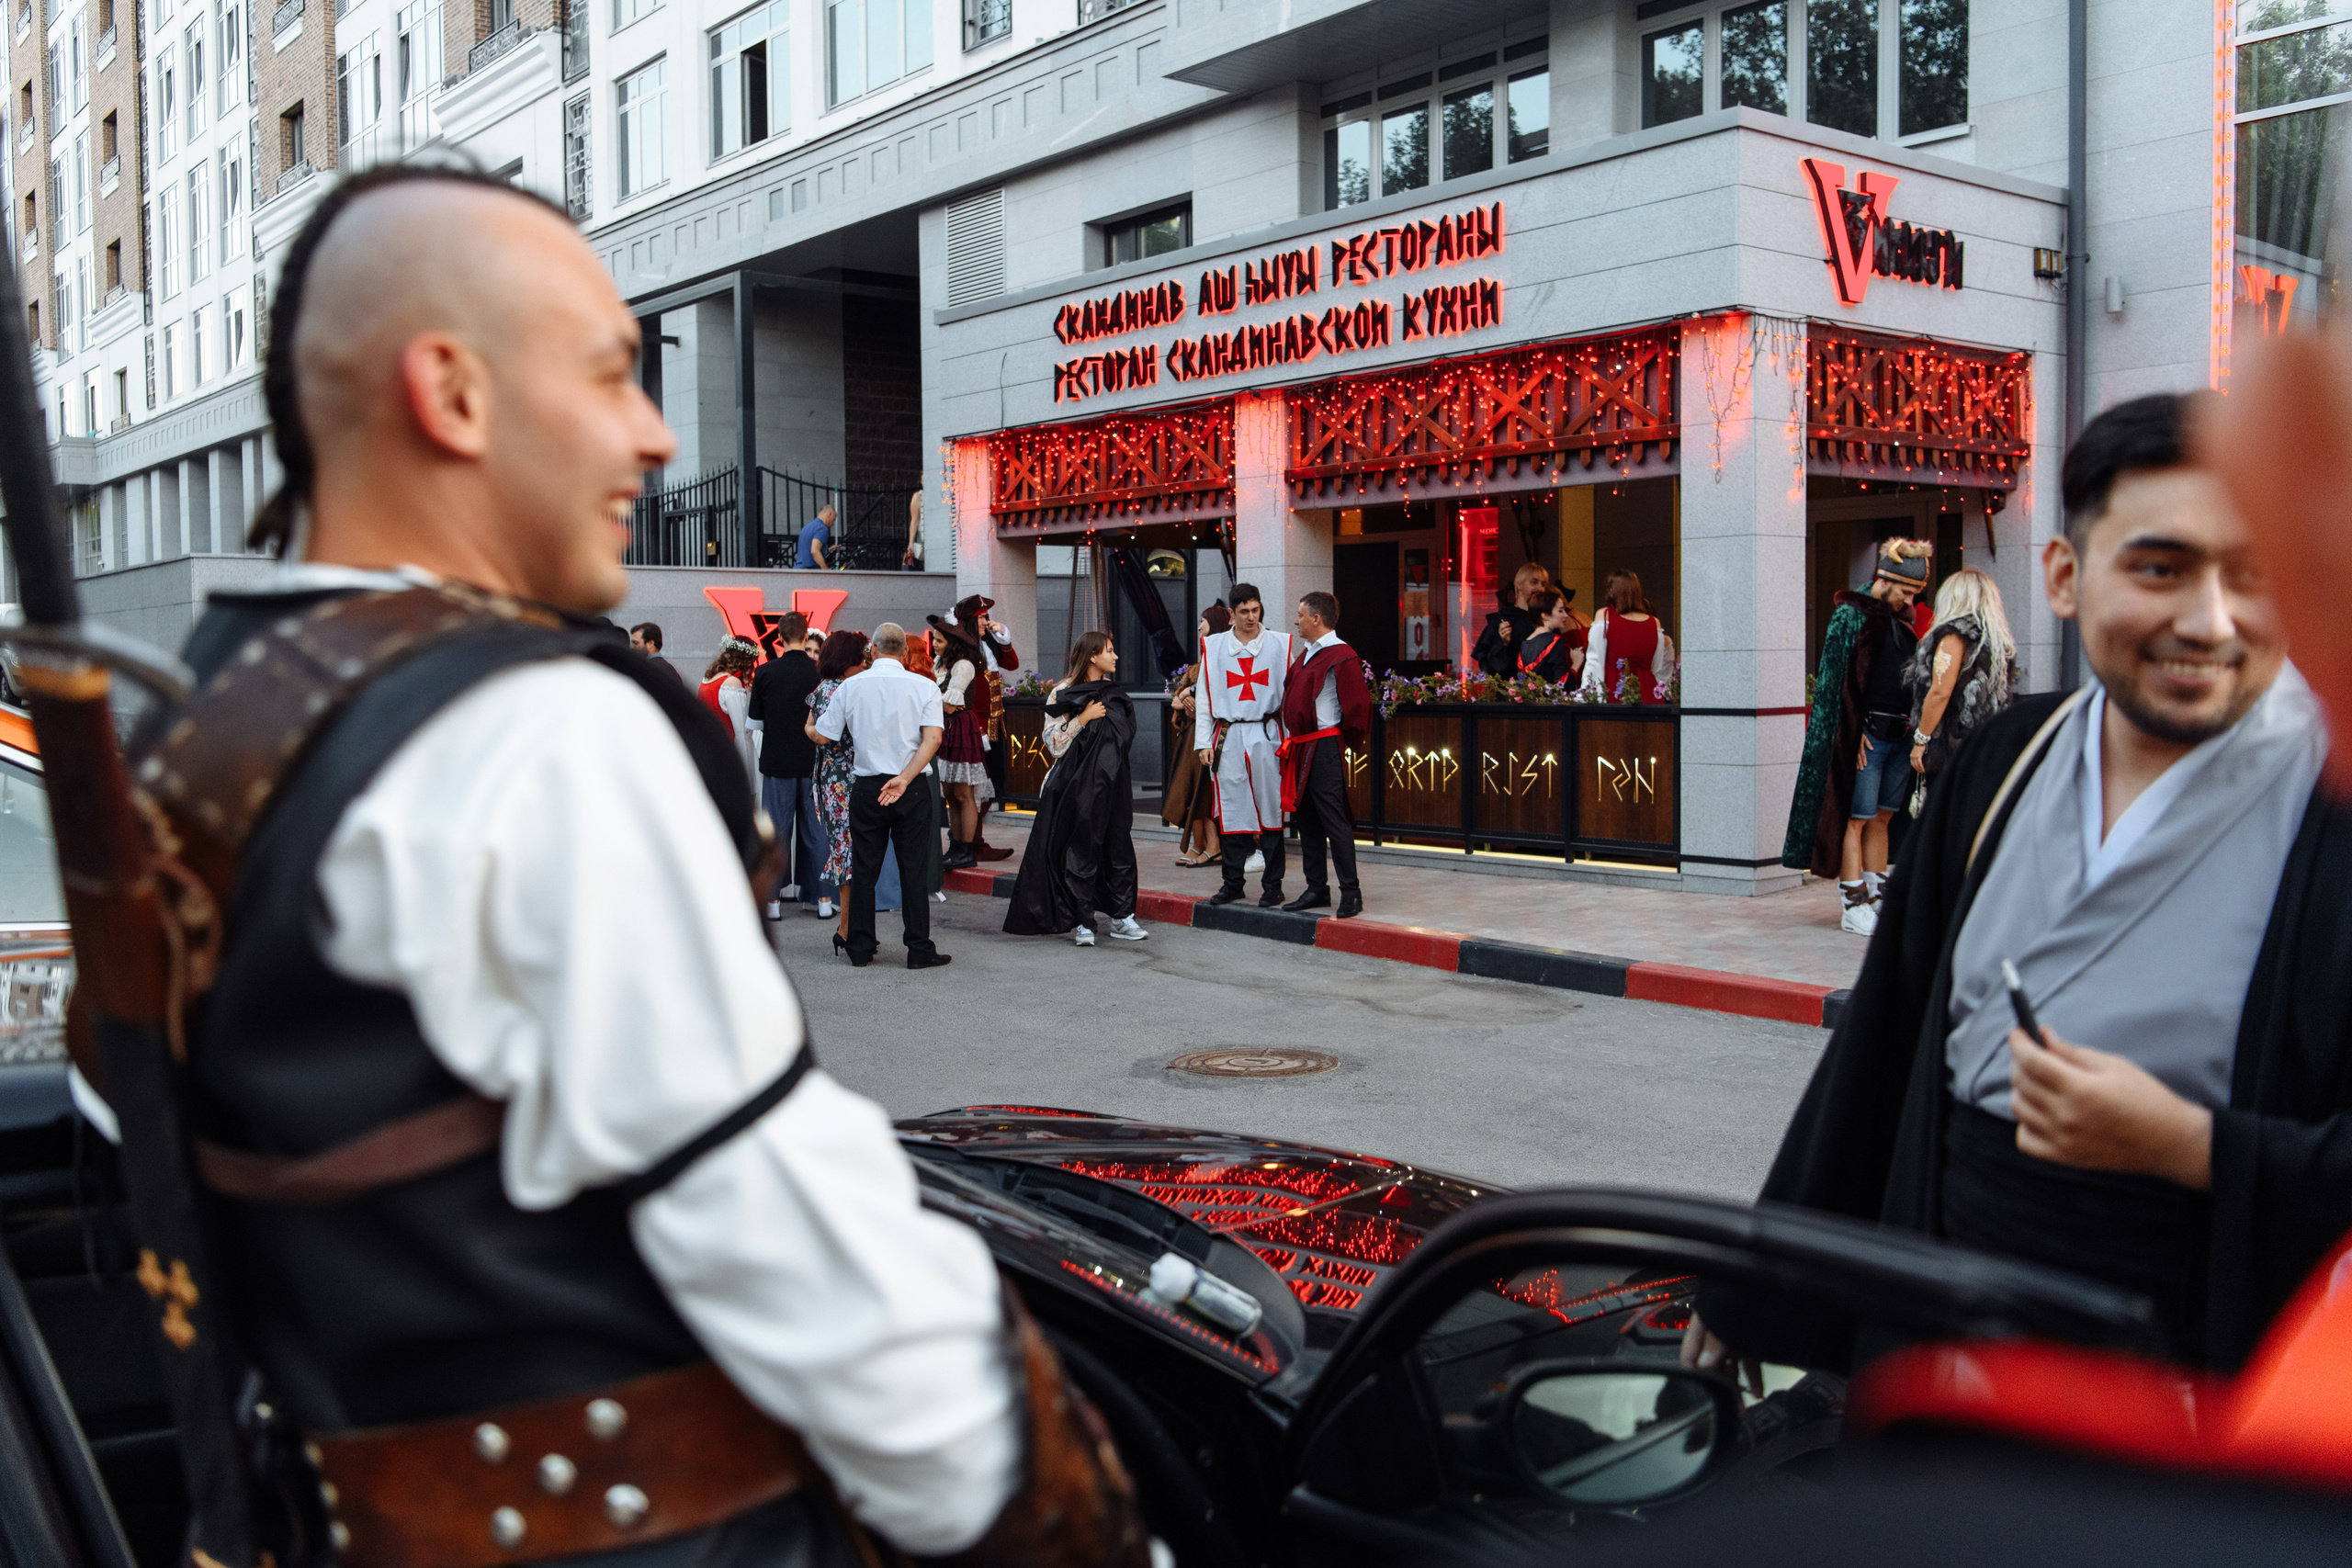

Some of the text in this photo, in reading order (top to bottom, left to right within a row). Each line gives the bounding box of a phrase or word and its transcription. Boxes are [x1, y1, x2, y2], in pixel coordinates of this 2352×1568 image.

[1054, 279, 1186, 345] СКАНДИНАВ
[1198, 265, 1239, 317] АШ
[1331, 201, 1503, 288] РЕСТОРАНЫ
[1054, 344, 1159, 404] РЕСТОРАН
[1403, 277, 1503, 344] КУХНИ
